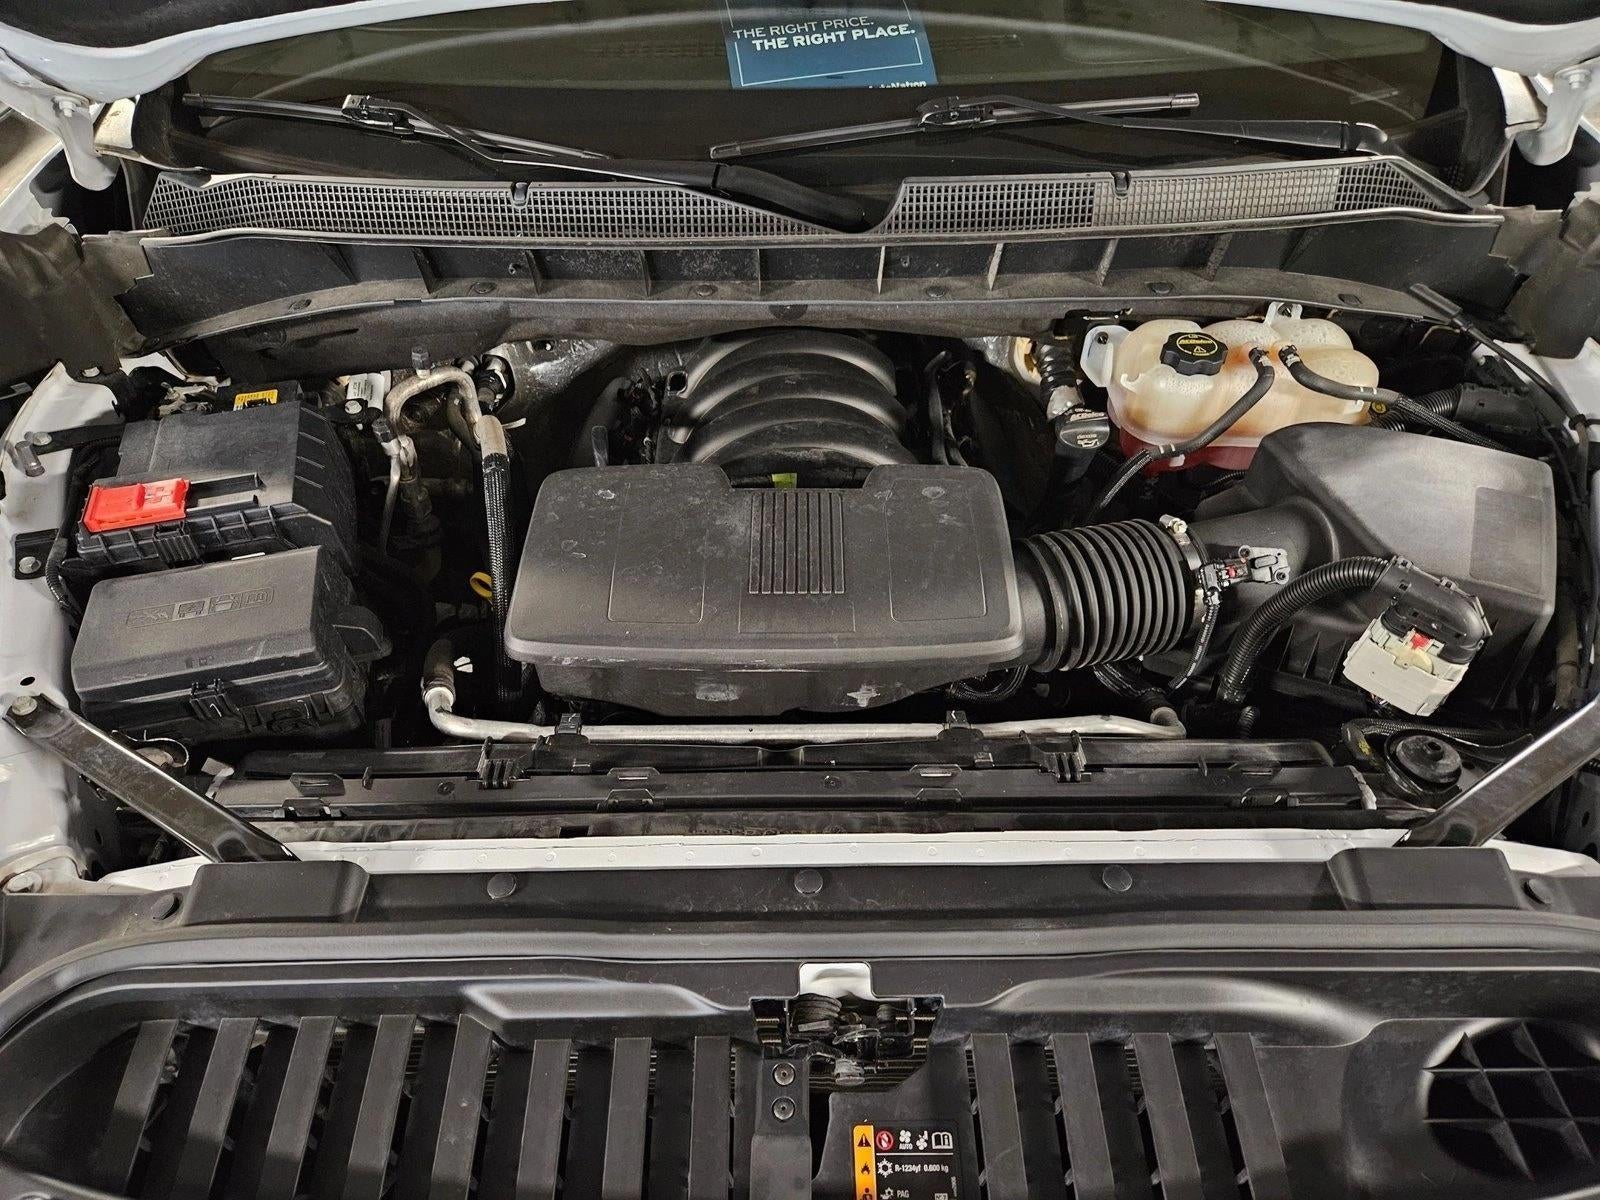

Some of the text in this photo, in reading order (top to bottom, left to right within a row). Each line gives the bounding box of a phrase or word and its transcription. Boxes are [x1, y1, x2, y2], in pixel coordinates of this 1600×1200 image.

[733, 16, 874, 39] THE RIGHT PRICE.
[752, 24, 916, 51] THE RIGHT PLACE.
[941, 1164, 949, 1174] kg
[897, 1190, 909, 1198] PAG
